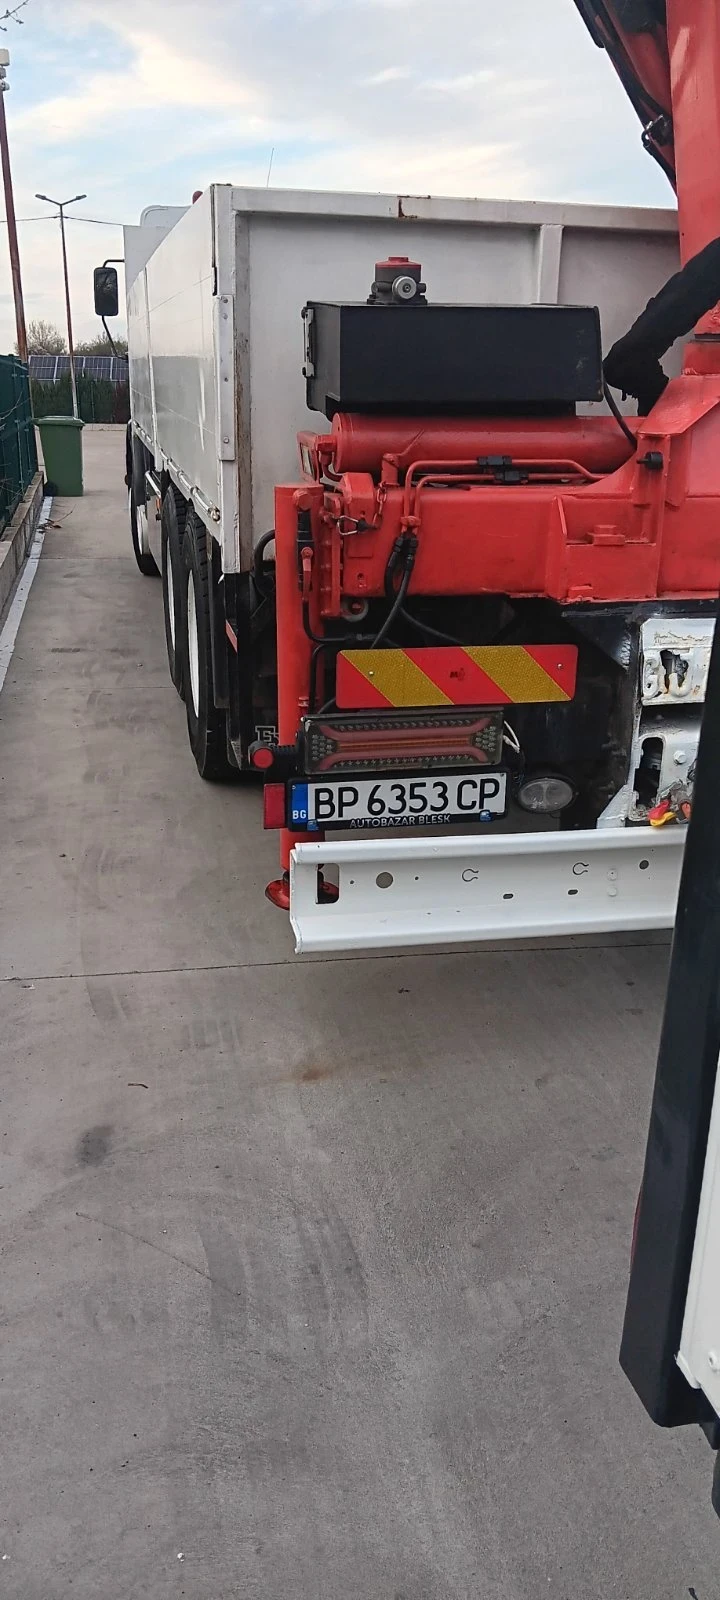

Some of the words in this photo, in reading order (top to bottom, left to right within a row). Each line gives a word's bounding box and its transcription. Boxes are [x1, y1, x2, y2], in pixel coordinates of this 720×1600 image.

[315, 786, 359, 820] BP
[367, 781, 449, 816] 6353
[457, 778, 500, 811] CP
[292, 810, 307, 820] BG
[349, 816, 416, 829] AUTOBAZAR
[418, 814, 451, 825] BLESK
